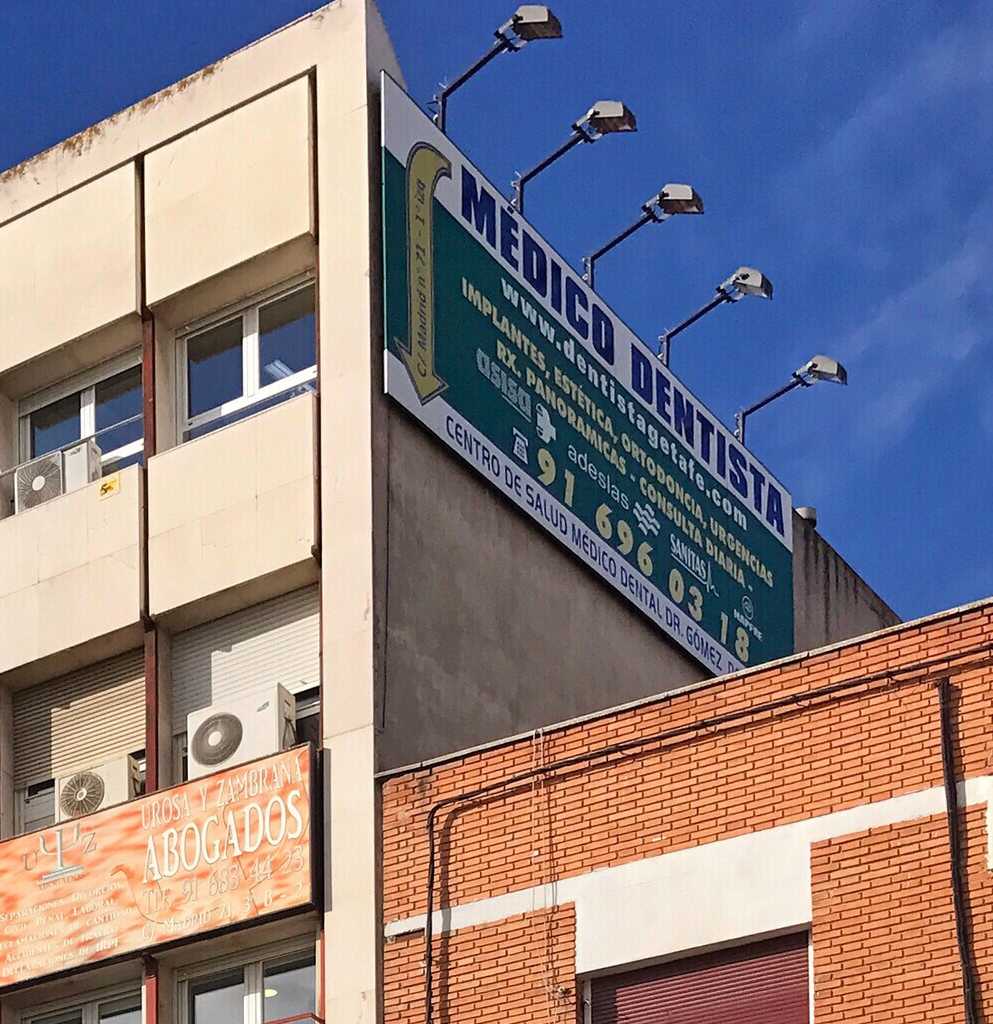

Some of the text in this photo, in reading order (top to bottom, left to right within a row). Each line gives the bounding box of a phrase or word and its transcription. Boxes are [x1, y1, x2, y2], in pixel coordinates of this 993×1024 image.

[461, 165, 785, 538] MÉDICO DENTISTA
[501, 277, 748, 531] www.dentistagetafe.com
[496, 339, 521, 378] RX.
[639, 473, 703, 548] CONSULTA
[706, 537, 745, 588] DIARIA
[567, 444, 629, 510] adeslas
[445, 415, 722, 671] CENTRO DE SALUD MÉDICO DENTAL DR. GÓMEZ
[537, 448, 749, 663] 91 696 03 18
[670, 533, 706, 580] SANITAS
[710, 516, 773, 588] URGENCIAS
[141, 789, 303, 884] ABOGADOS
[217, 756, 303, 809] ZAMBRANA
